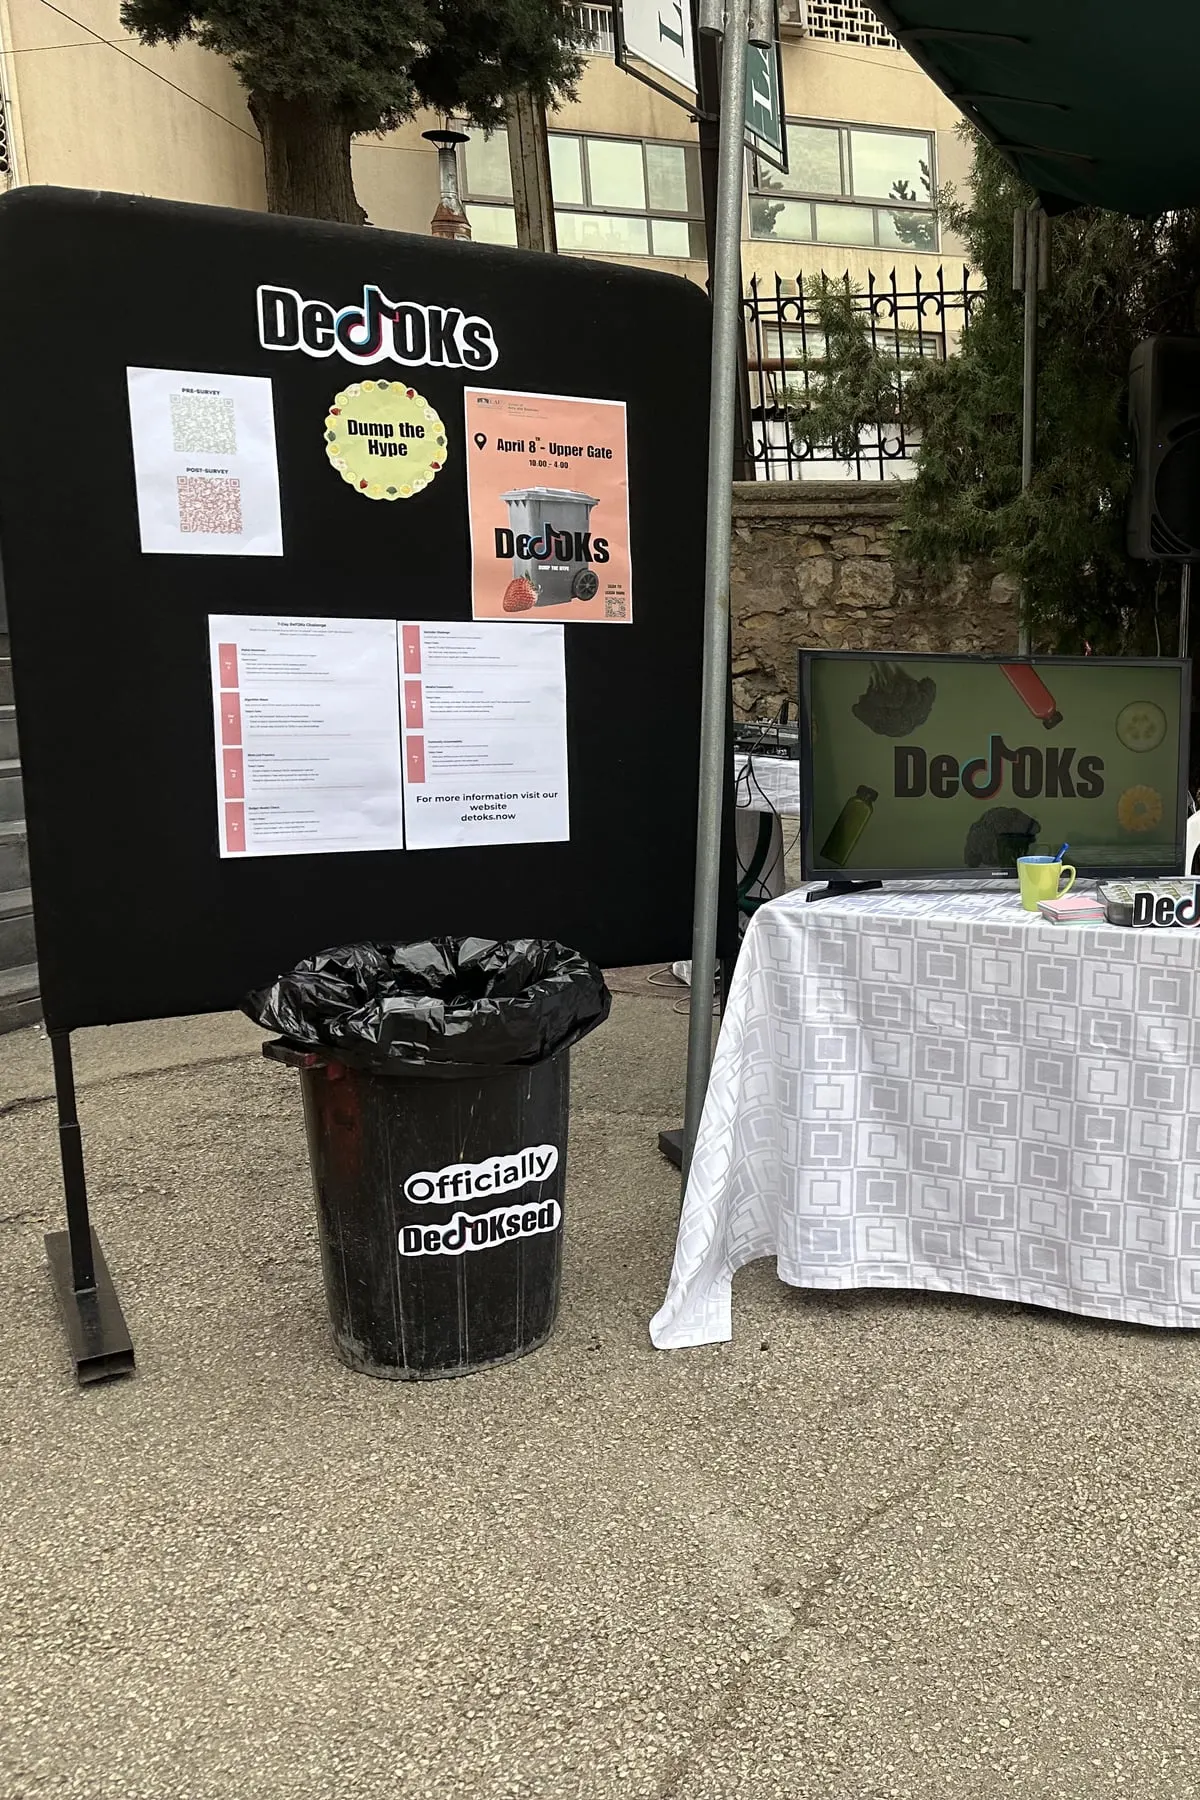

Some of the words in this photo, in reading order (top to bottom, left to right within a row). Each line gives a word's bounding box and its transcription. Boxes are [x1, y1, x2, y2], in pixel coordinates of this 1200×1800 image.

[181, 387, 221, 396] PRE-SURVEY
[347, 419, 394, 438] Dump
[398, 422, 425, 439] the
[367, 439, 408, 457] Hype
[496, 438, 525, 453] April
[549, 442, 584, 457] Upper
[587, 445, 613, 459] Gate
[186, 467, 229, 475] POST-SURVEY
[416, 795, 432, 803] For
[462, 791, 518, 801] information
[520, 791, 540, 799] visit
[469, 802, 507, 811] website
[461, 812, 516, 822] detoks.now
[407, 1152, 553, 1201] Officially
